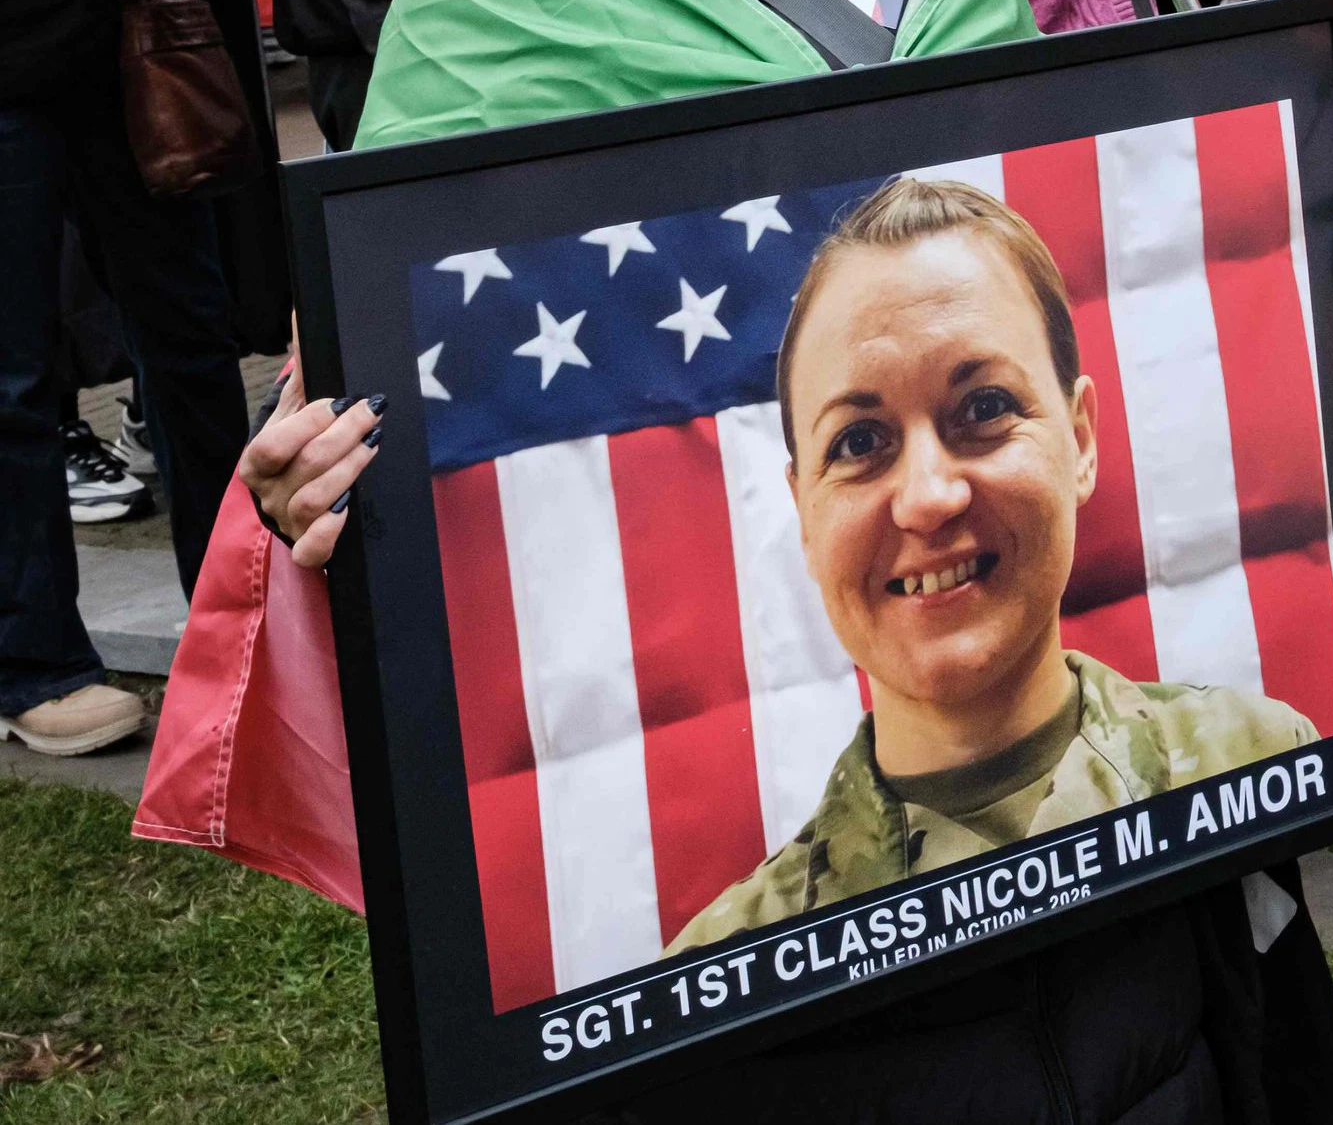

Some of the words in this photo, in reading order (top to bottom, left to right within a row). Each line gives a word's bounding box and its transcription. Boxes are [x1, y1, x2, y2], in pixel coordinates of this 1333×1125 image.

[541, 991, 653, 1062] SGT.
[671, 953, 756, 1016] 1ST
[774, 897, 927, 982] CLASS
[941, 837, 1102, 926] NICOLE
[1114, 810, 1169, 866] M.
[1186, 754, 1327, 842] AMOR
[849, 943, 921, 981] KILLED
[927, 933, 947, 953] IN
[955, 906, 1026, 944] ACTION
[1050, 883, 1091, 911] 2026
